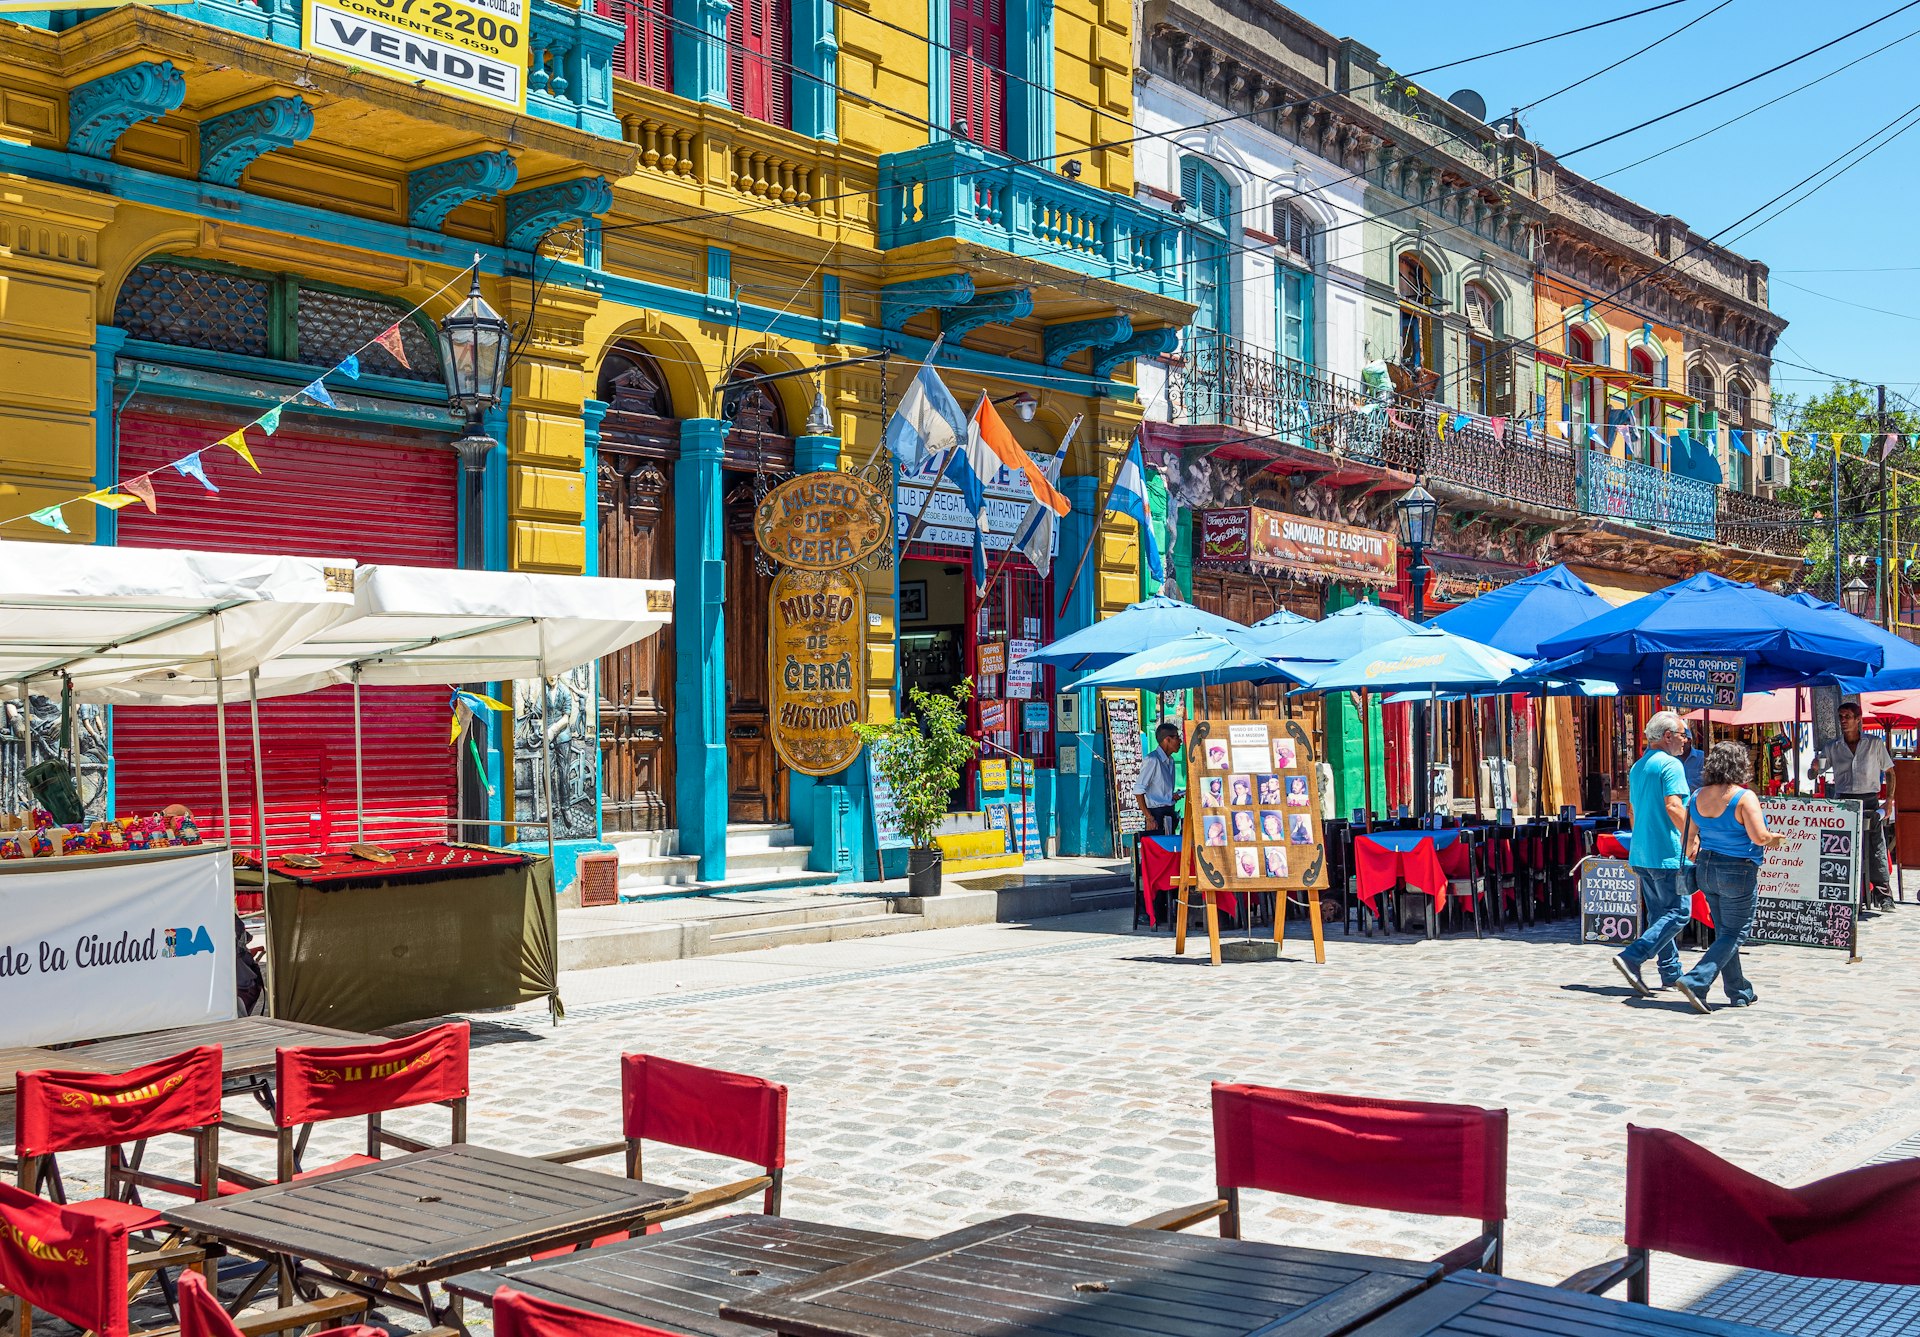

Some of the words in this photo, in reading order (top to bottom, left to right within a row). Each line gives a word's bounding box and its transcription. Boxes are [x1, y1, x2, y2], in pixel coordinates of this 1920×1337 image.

[339, 0, 454, 40] CORRIENTES
[460, 38, 499, 55] 4599
[376, 0, 518, 48] 7-2200
[330, 18, 505, 91] VENDE
[780, 481, 859, 517] MUSEO
[805, 510, 833, 533] DE
[1228, 515, 1246, 525] Bar
[786, 530, 855, 562] CERA
[1270, 518, 1280, 537] EL
[1282, 520, 1326, 546] SAMOVAR
[1327, 529, 1339, 548] DE
[1340, 531, 1382, 556] RASPUTIN
[780, 592, 854, 628] MUSEO
[806, 634, 828, 650] DE
[783, 653, 853, 691] CERA
[1668, 658, 1695, 669] PIZZA
[1698, 659, 1738, 671] GRANDE
[1667, 669, 1706, 682] CASERA
[1666, 681, 1714, 694] CHORIPAN
[1760, 802, 1787, 810] CLUB
[1791, 804, 1835, 813] ZARATE
[1787, 815, 1800, 826] de
[1803, 816, 1845, 829] TANGO
[1769, 856, 1804, 867] Grande
[1596, 865, 1625, 878] CAFÉ
[1586, 878, 1635, 891] EXPRESS
[0, 945, 32, 978] de
[39, 940, 69, 973] la
[75, 928, 159, 969] Ciudad
